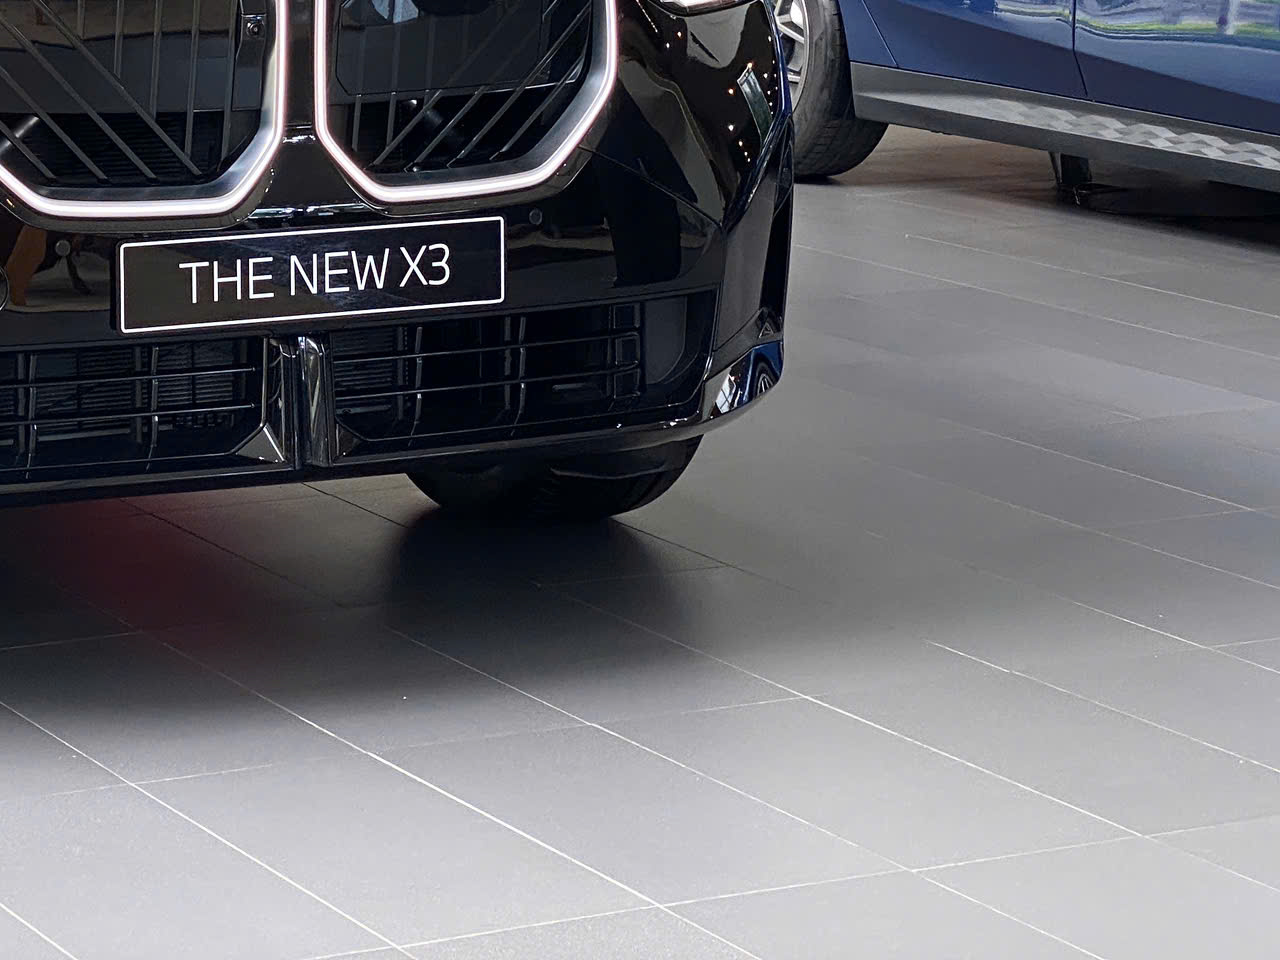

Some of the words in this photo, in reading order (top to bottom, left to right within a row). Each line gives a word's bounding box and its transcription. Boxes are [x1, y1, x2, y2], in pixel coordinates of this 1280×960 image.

[179, 256, 275, 304] THE
[290, 247, 390, 296] NEW
[399, 243, 451, 288] X3
